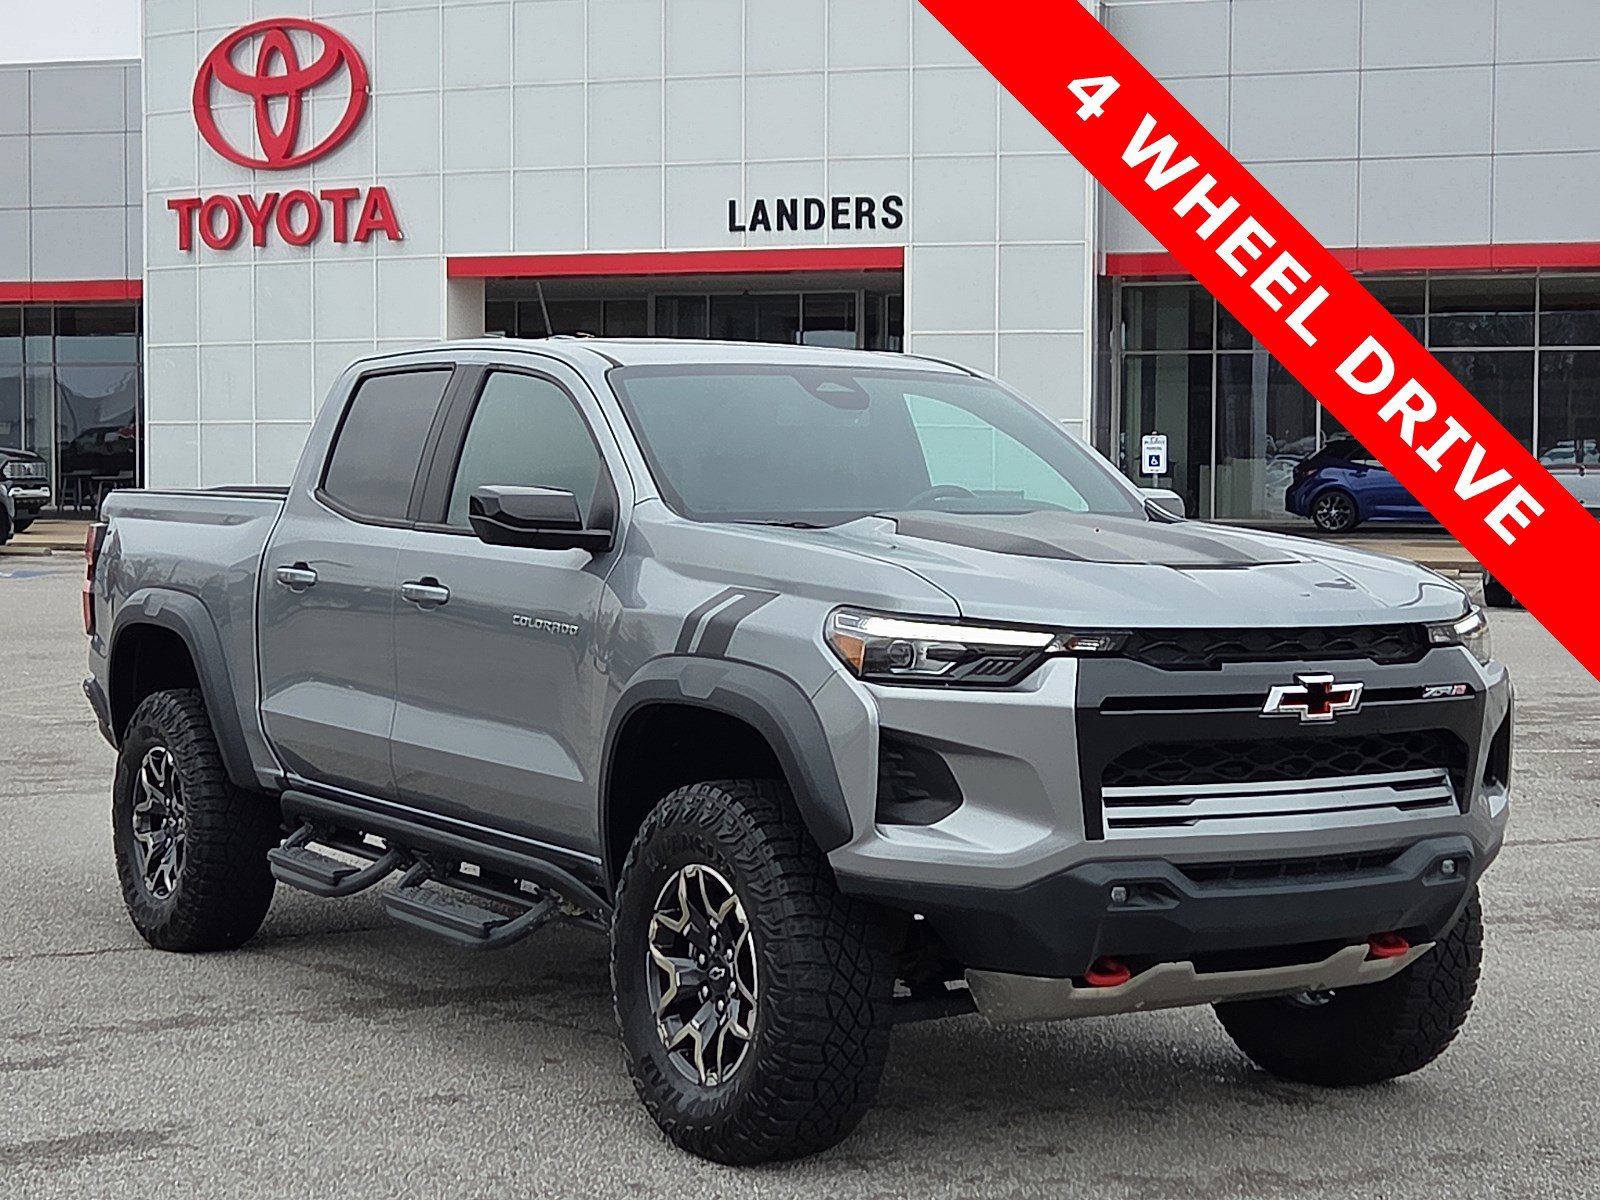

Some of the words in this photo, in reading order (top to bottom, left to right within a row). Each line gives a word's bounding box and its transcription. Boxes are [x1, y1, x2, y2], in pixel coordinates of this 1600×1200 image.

[168, 186, 403, 250] TOYOTA
[728, 195, 904, 232] LANDERS
[512, 614, 579, 635] COLORADO
